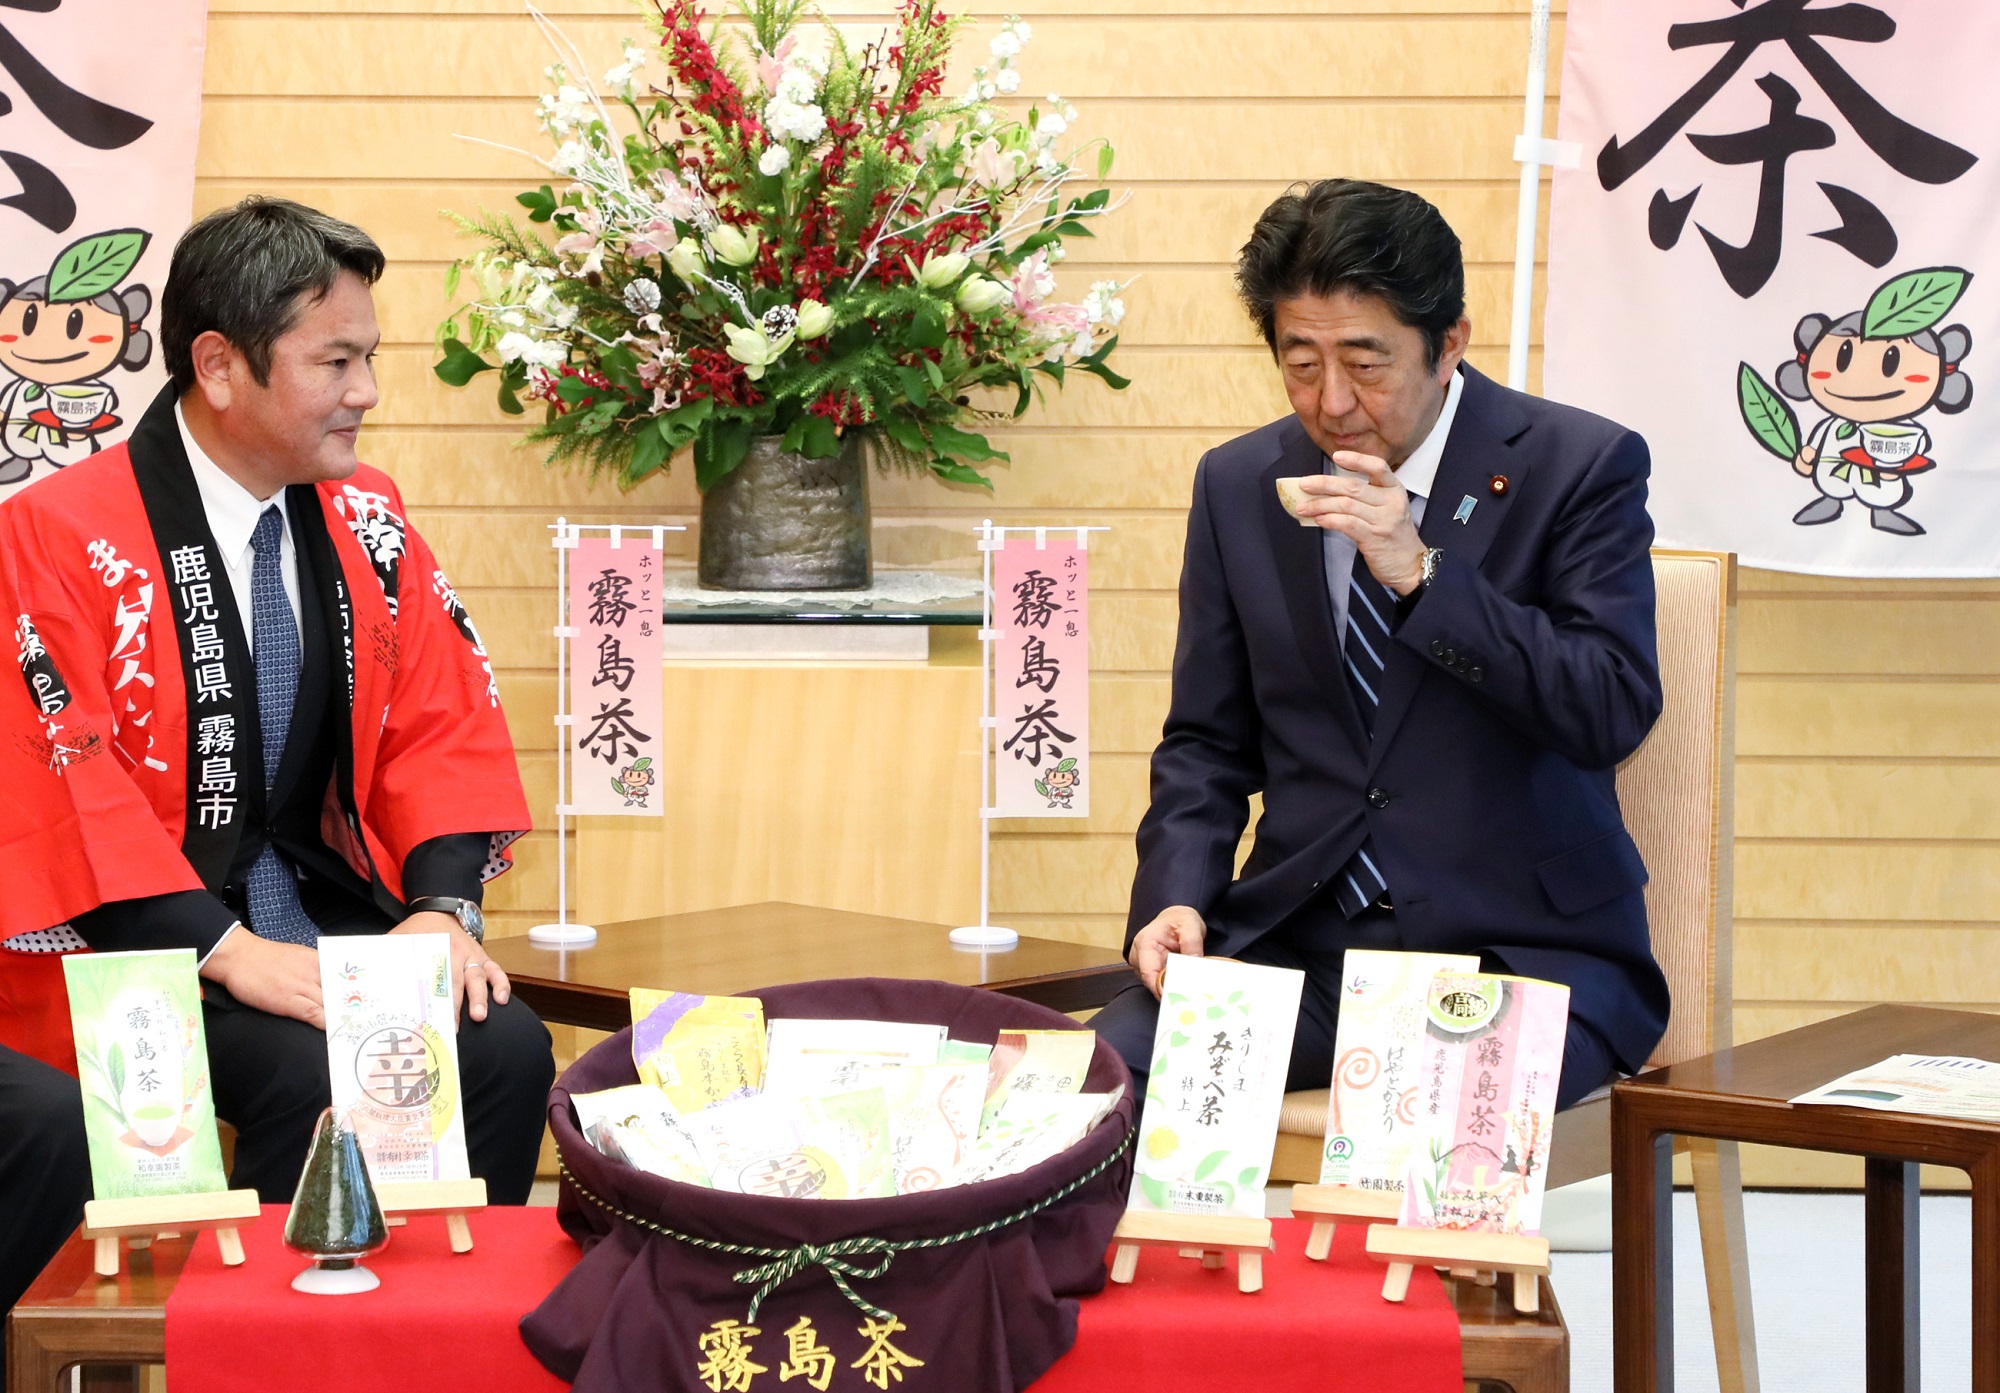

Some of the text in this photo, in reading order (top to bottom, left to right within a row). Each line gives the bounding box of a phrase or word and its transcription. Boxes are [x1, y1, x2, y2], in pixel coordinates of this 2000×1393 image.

[56, 401, 98, 415] 霧島茶
[1870, 440, 1911, 455] 霧島茶
[638, 555, 653, 637] ホッと一息
[1064, 555, 1079, 637] ホッと一息
[169, 545, 237, 830] 鹿児島県 霧島市
[579, 568, 652, 766] 霧島茶
[1003, 569, 1077, 767] 霧島茶
[127, 1006, 162, 1092] 霧島茶
[366, 1031, 427, 1101] 幸
[1196, 1031, 1233, 1126] みぞべ茶
[1233, 1027, 1252, 1091] きりしま
[1467, 1037, 1504, 1136] 霧島茶
[697, 1315, 925, 1393] 霧島茶
